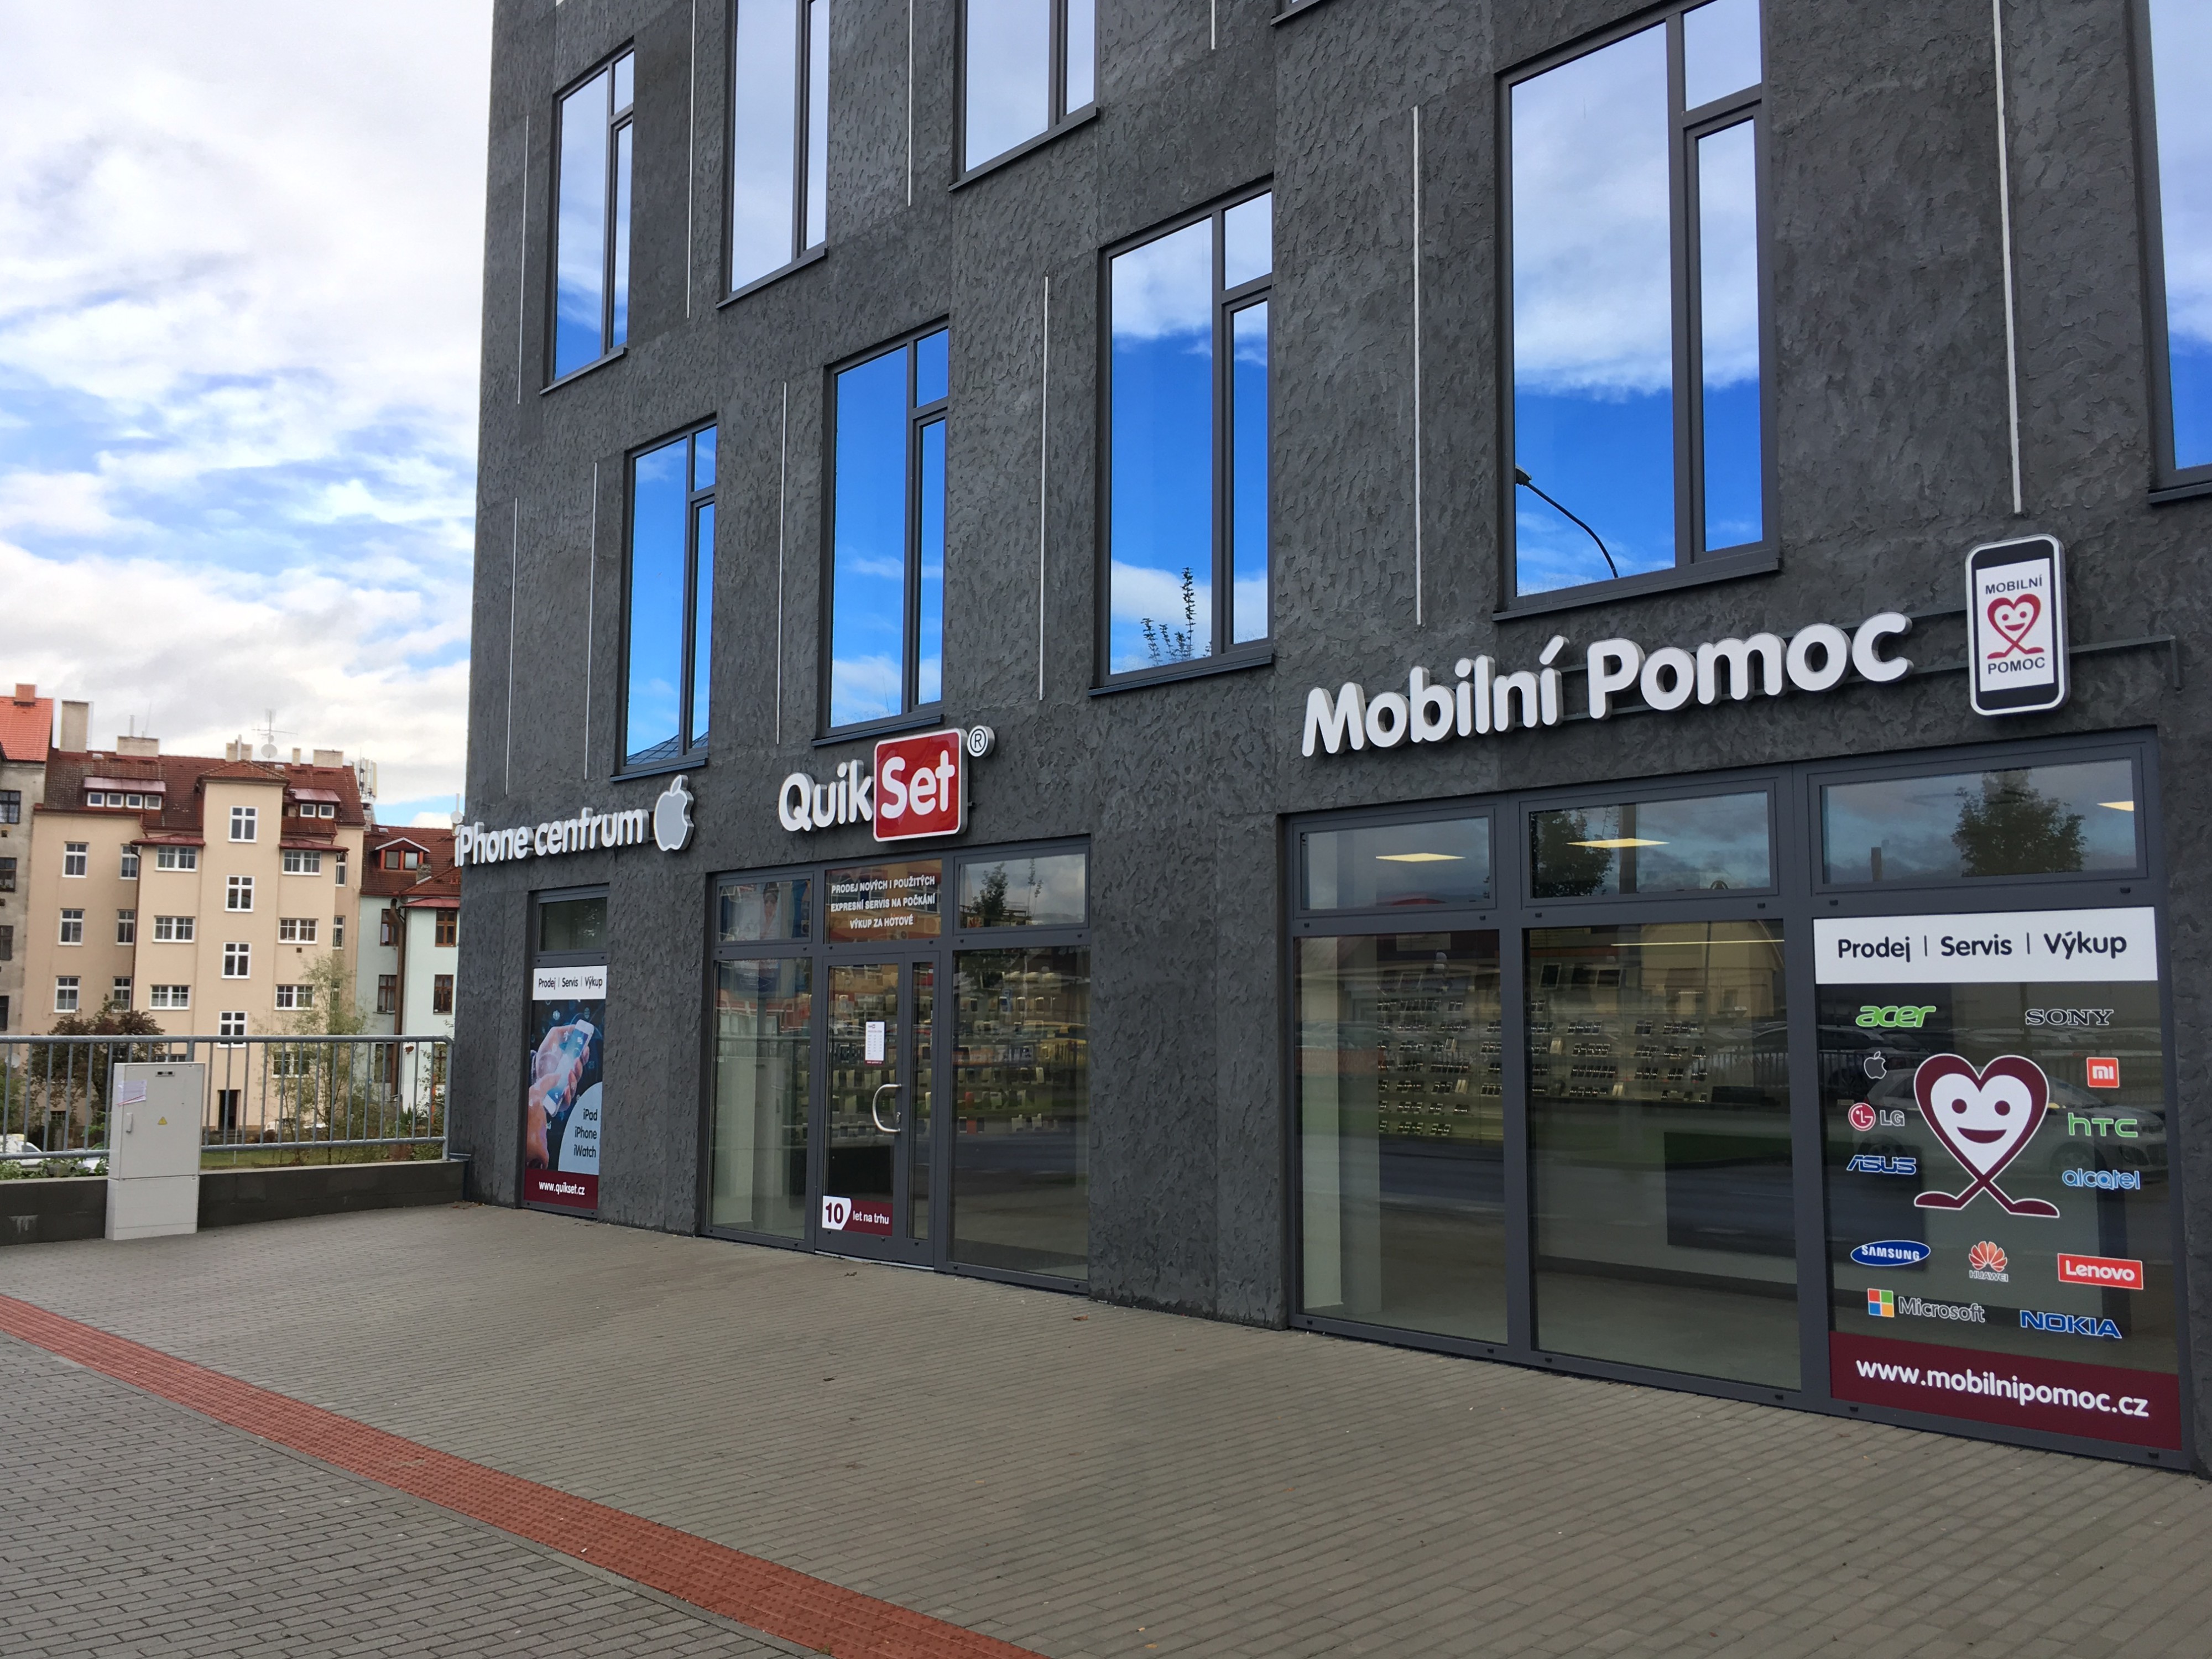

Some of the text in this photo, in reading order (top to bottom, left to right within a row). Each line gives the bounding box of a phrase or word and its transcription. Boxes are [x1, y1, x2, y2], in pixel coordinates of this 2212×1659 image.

[1985, 574, 2042, 594] MOBILNÍ
[1987, 657, 2045, 674] POMOC
[1302, 612, 1913, 757] Mobilní Pomoc
[454, 807, 649, 867] iPhone centrum
[831, 883, 858, 894] PRODEJ
[860, 879, 887, 891] NOVÝCH
[894, 874, 935, 888] POUŽITÝCH
[831, 893, 935, 912] EXPRESNÍ SERVIS NA POČKÁNÍ
[850, 914, 914, 929] VÝKUP ZA HOTOVÉ
[1838, 931, 2127, 962] Prodej Servis Výkup
[538, 976, 603, 989] Prodej Servis Výkup
[1855, 1005, 1937, 1027] acer
[2025, 1009, 2114, 1025] SONY
[583, 1108, 598, 1120] iPad
[1880, 1110, 1905, 1126] LG
[575, 1126, 597, 1139] iPhone
[574, 1145, 596, 1157] iWatch
[1846, 1154, 1917, 1175] ASUS
[539, 1181, 585, 1196] www.quikset.cz
[2062, 1168, 2140, 1190] alcatel
[825, 1202, 889, 1224] 10 let na trhu
[1861, 1245, 1921, 1261] SAMSUNG
[1969, 1270, 2008, 1282] HUAWEI
[2065, 1260, 2135, 1281] Lenovo
[1898, 1296, 1985, 1323] Microsoft
[2020, 1310, 2122, 1339] NOKIA
[1856, 1360, 2149, 1417] www.mobilnipomoc.cz
